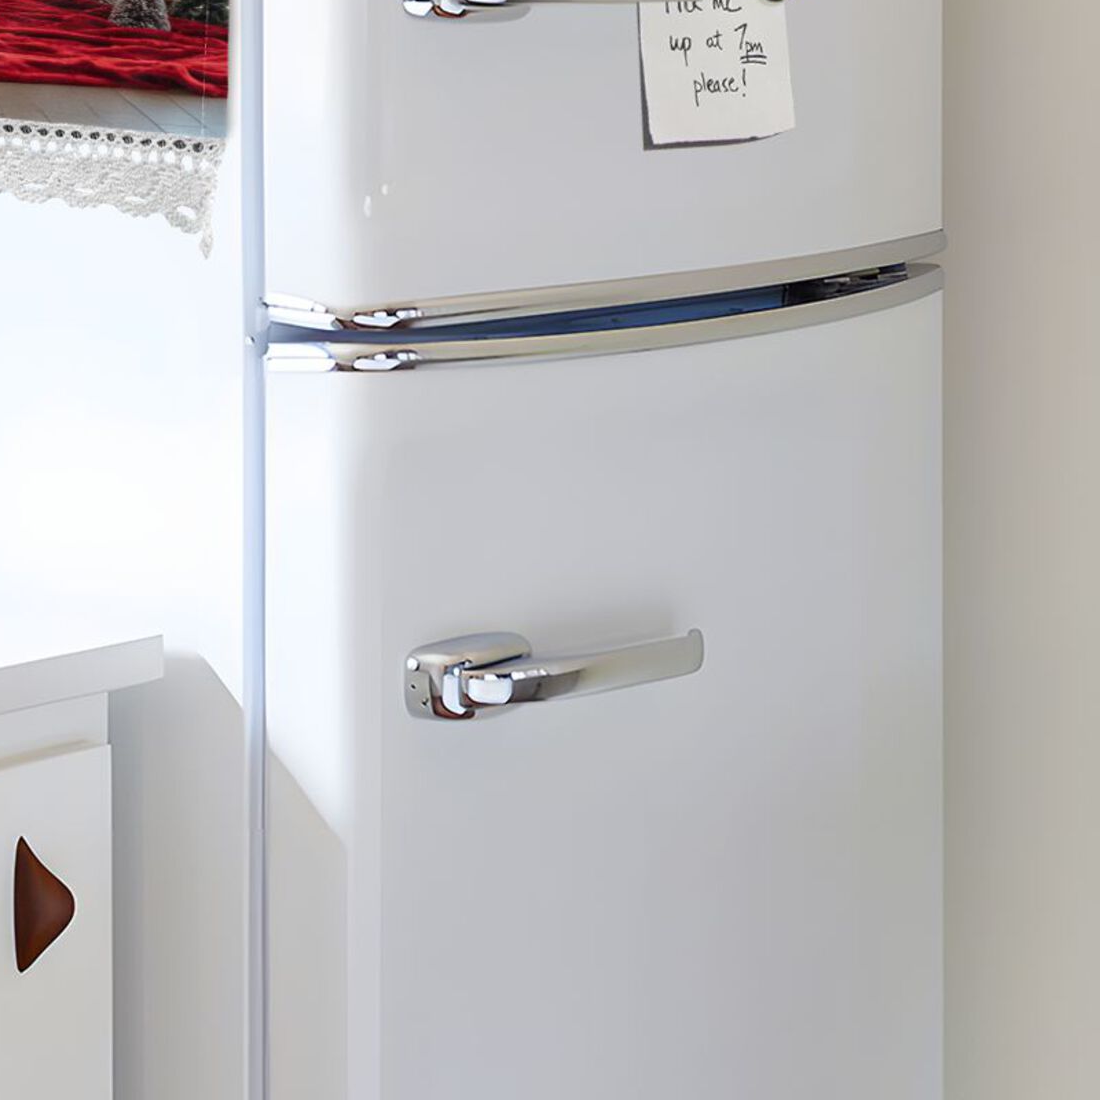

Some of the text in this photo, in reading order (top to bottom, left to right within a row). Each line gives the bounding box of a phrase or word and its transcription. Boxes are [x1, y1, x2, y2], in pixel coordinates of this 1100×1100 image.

[669, 35, 692, 66] up
[706, 30, 723, 50] at
[693, 68, 746, 107] please!
